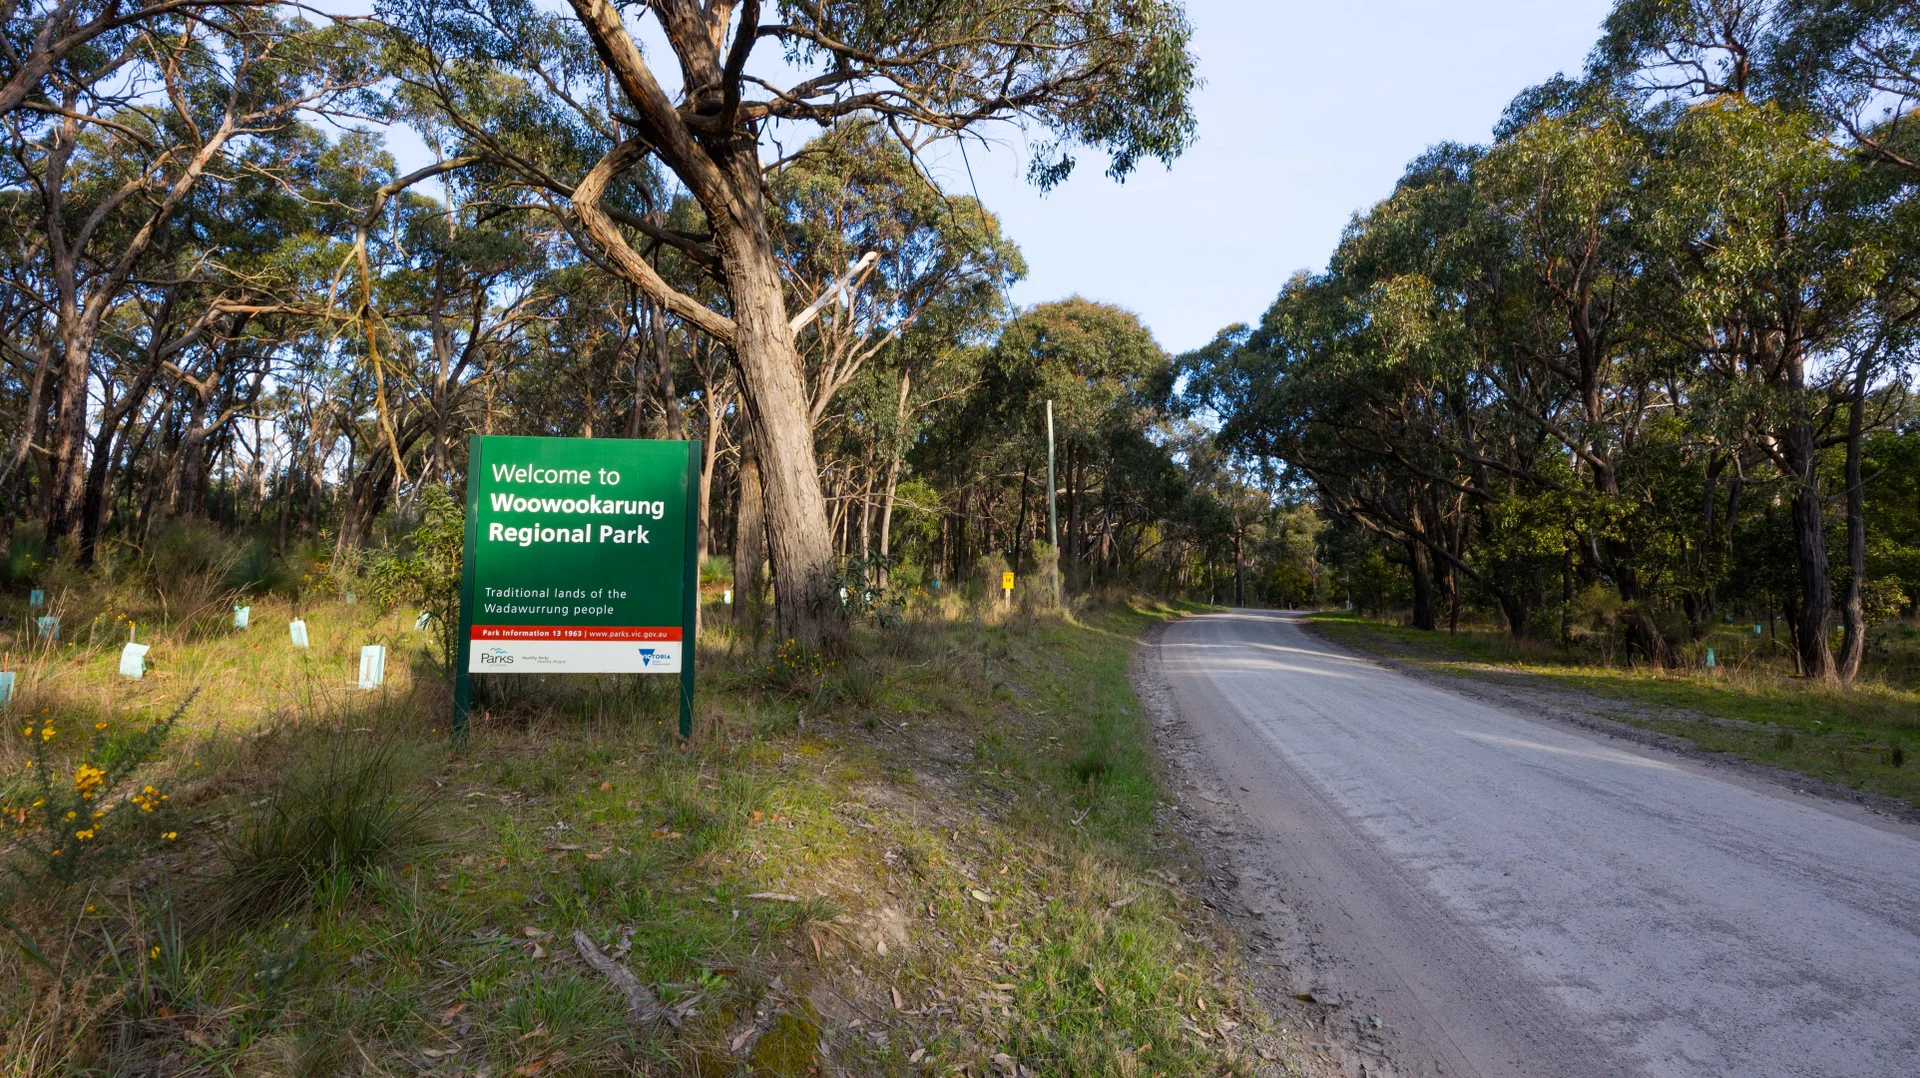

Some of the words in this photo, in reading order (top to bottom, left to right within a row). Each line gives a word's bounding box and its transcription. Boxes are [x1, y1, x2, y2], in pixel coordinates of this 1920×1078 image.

[492, 463, 591, 485] Welcome
[599, 467, 621, 485] to
[490, 493, 665, 520] Woowookarung
[489, 523, 591, 546] Regional
[599, 525, 650, 544] Park
[485, 587, 550, 598] Traditional
[554, 588, 585, 599] lands
[590, 588, 603, 599] of
[607, 589, 627, 599] the
[484, 603, 569, 616] Wadawurrung
[574, 604, 614, 616] people
[482, 629, 500, 637] Park
[502, 629, 550, 637] Information
[589, 630, 667, 639] www.parks.vic.gov.au
[481, 653, 514, 664] Parks
